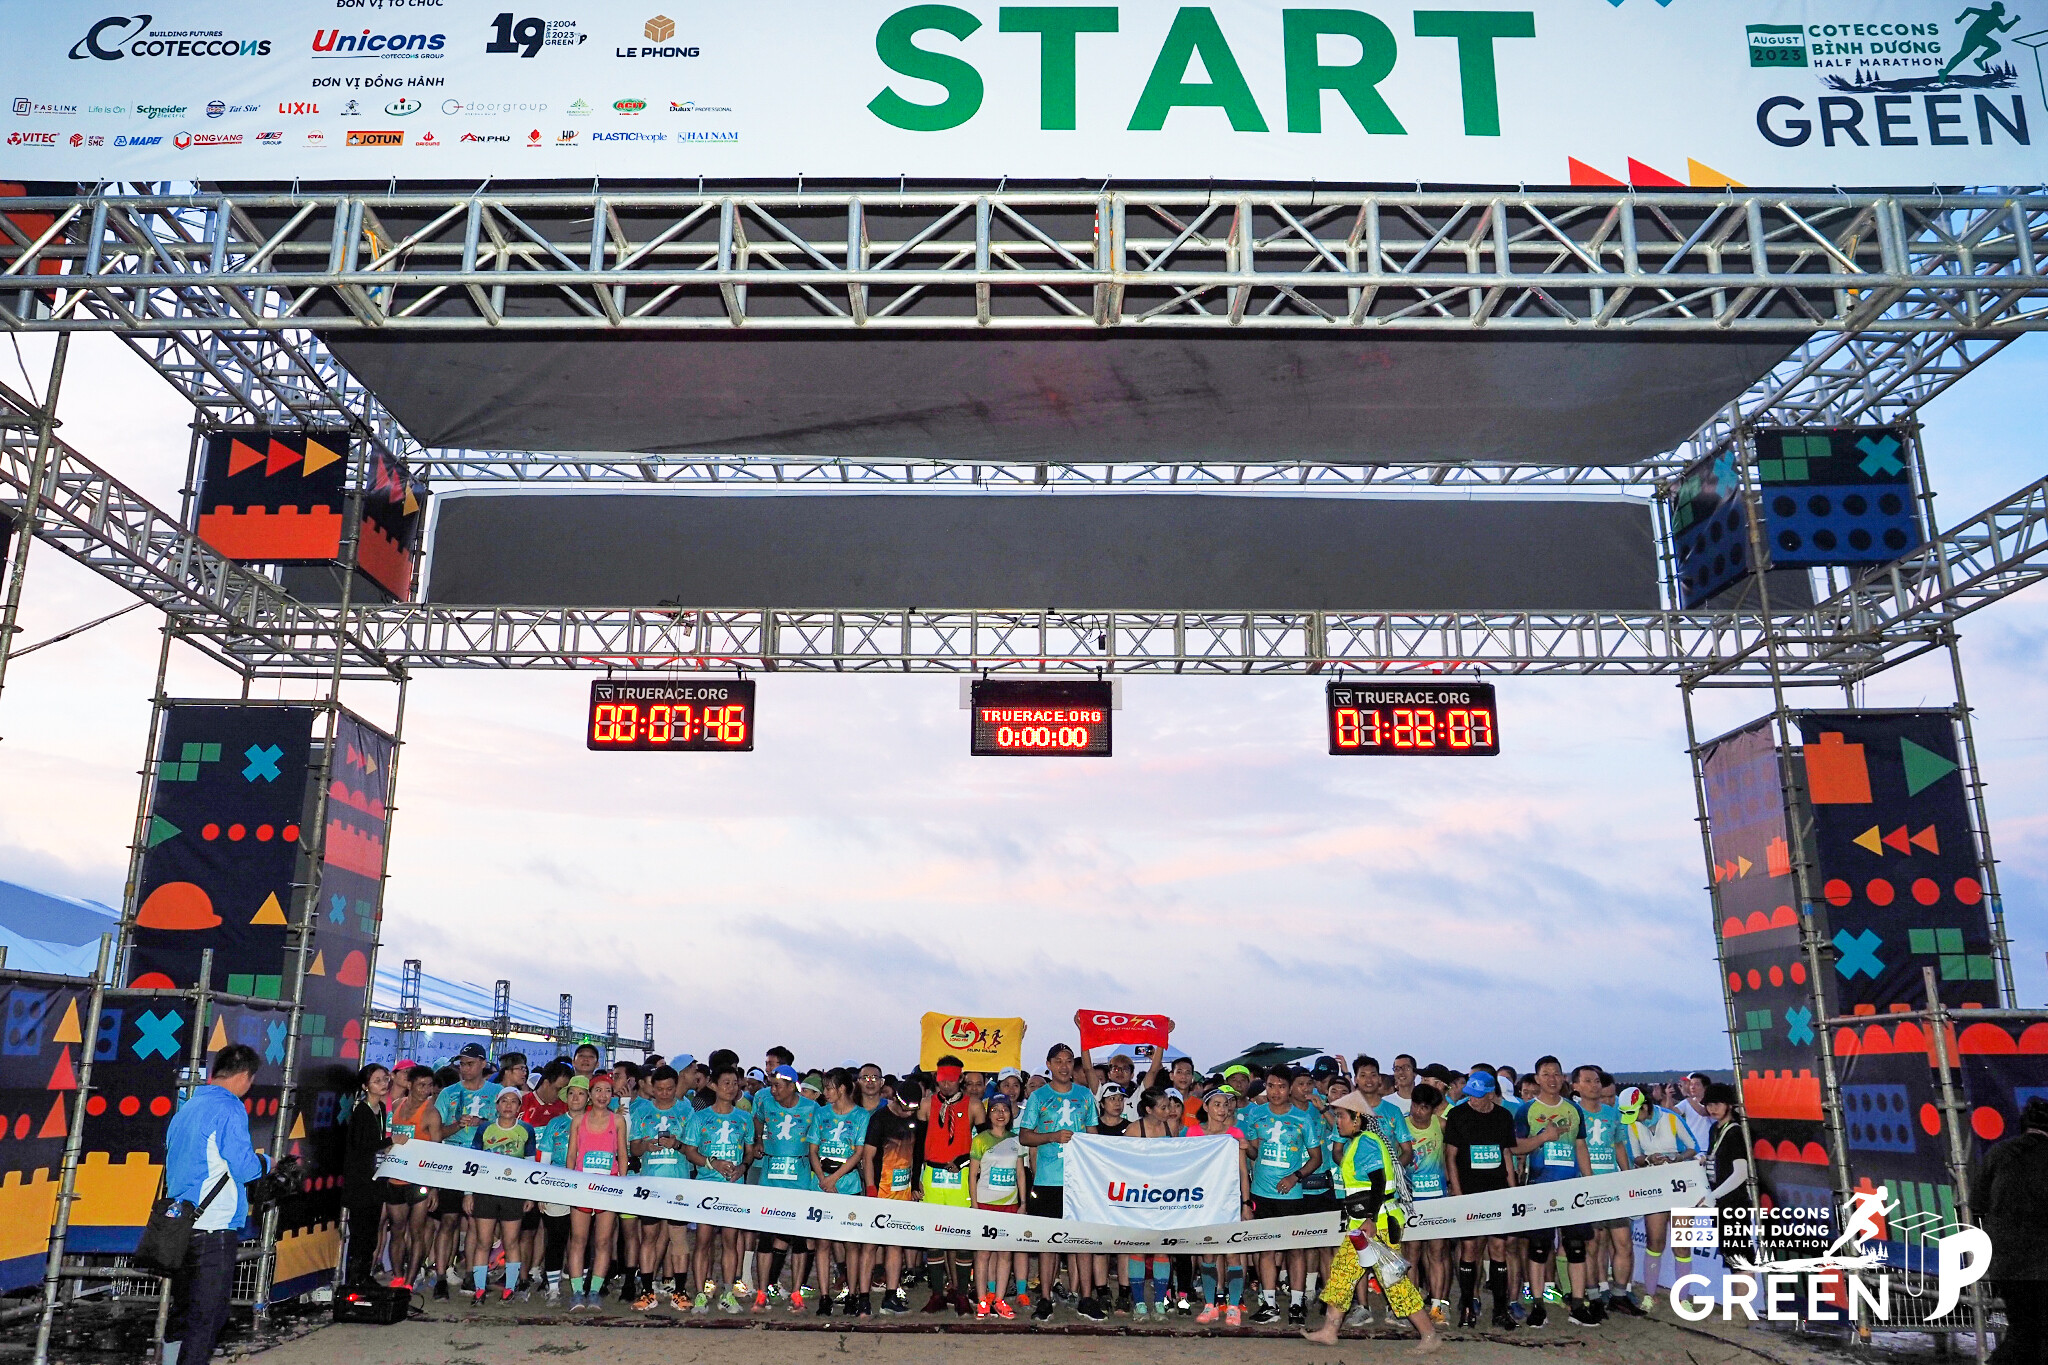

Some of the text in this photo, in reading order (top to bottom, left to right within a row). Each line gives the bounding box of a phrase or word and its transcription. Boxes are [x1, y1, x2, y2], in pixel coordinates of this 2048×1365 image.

[486, 13, 545, 58] 19
[1808, 23, 1939, 37] COTECCONS
[312, 29, 446, 51] Unicons
[1753, 36, 1800, 44] AUGUST
[616, 47, 699, 58] LE PHONG
[1812, 40, 1941, 55] BÌNH DƯƠNG
[1754, 49, 1801, 61] 2023
[1814, 58, 1944, 68] HALF MARATHON
[866, 4, 1536, 136] START
[312, 77, 341, 87] ĐƠN
[345, 77, 360, 90] VỊ
[34, 104, 77, 112] FASLINK
[88, 105, 103, 113] Life
[137, 105, 187, 119] Schneider
[228, 105, 242, 113] Tai
[279, 102, 319, 114] LIXIL
[466, 102, 548, 113] doorgroup
[1756, 94, 2031, 147] GREEN
[22, 133, 57, 142] VITEC
[129, 137, 163, 145] MAPEI
[361, 134, 402, 144] JOTUN
[616, 687, 728, 700] TRUERACE.ORG
[1355, 691, 1470, 704] TRUERACE.ORG
[981, 710, 1101, 722] TRUERACE.ORG
[594, 704, 747, 744] 00:07:46
[1337, 709, 1493, 748] 01:22:07
[997, 726, 1088, 747] 0:00:00
[711, 1150, 736, 1158] 22045
[822, 1146, 846, 1155] 21807
[1474, 1152, 1499, 1160] 21586
[586, 1157, 610, 1165] 21021
[1590, 1153, 1612, 1161] 21075
[419, 1160, 453, 1171] Unicons
[462, 1161, 479, 1176] 19
[991, 1174, 1015, 1182] 21154
[1414, 1180, 1439, 1188] 21820
[588, 1182, 624, 1195] Unicons
[1671, 1179, 1687, 1193] 19
[633, 1186, 650, 1200] 19
[1107, 1182, 1204, 1203] Unicons
[1629, 1187, 1662, 1198] Unicons
[760, 1206, 796, 1218] Unicons
[806, 1206, 823, 1222] 19
[1466, 1211, 1502, 1221] Unicons
[1511, 1203, 1526, 1217] 19
[934, 1224, 971, 1235] Unicons
[981, 1225, 998, 1239] 19
[1291, 1228, 1328, 1236] Unicons
[1160, 1238, 1178, 1246] 19
